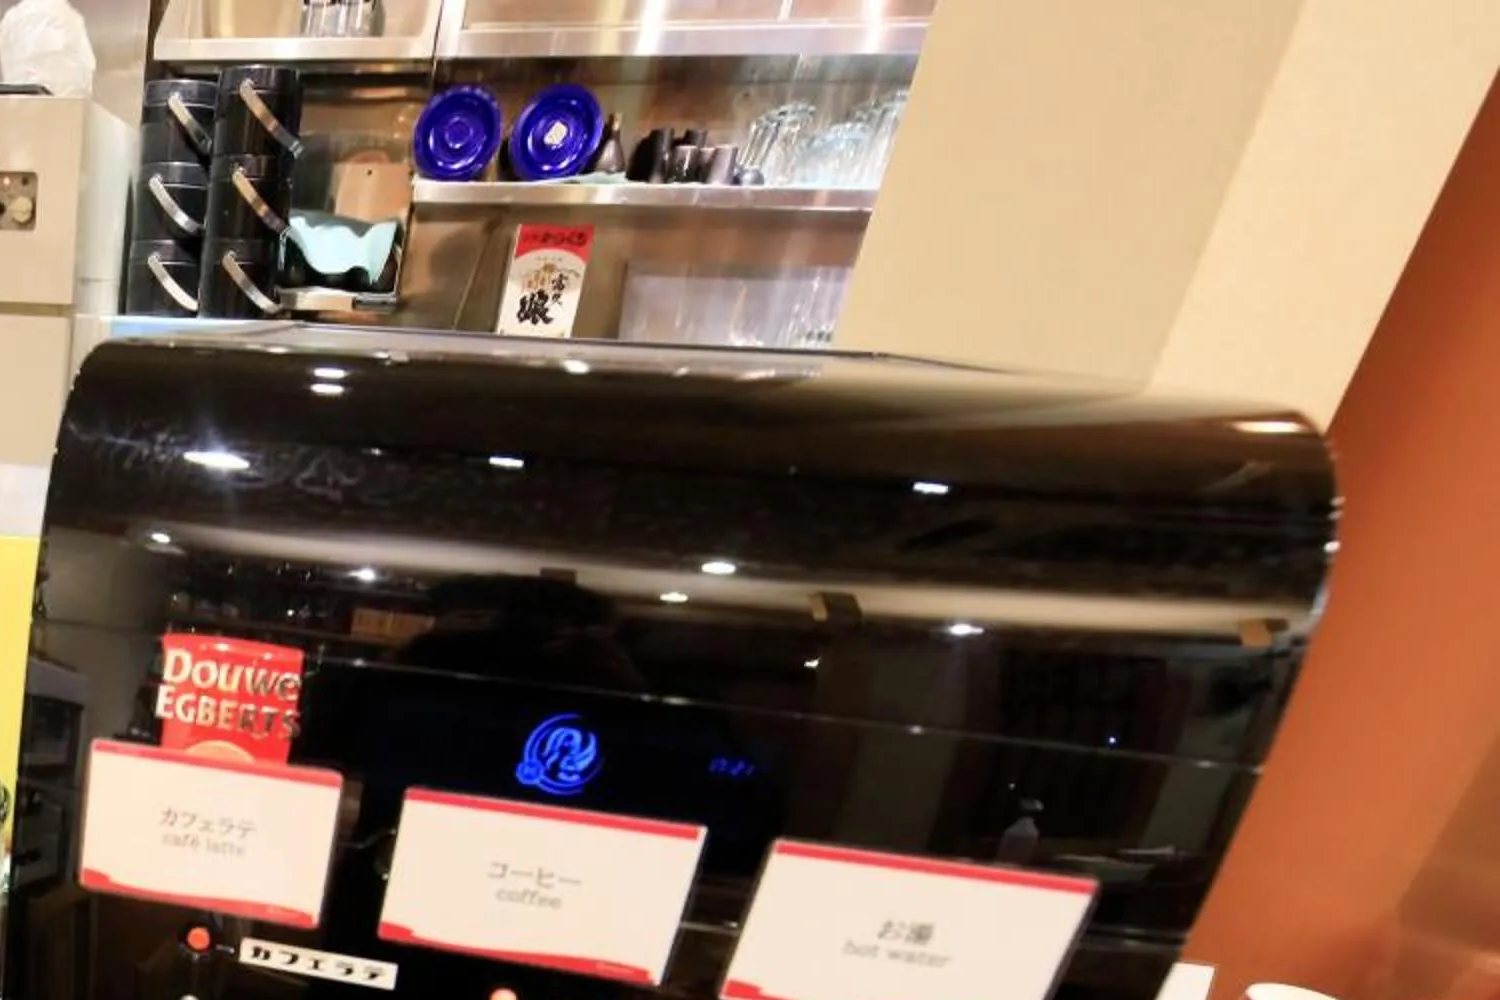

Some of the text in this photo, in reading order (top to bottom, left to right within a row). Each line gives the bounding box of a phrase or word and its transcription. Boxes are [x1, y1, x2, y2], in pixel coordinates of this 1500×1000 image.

[156, 684, 300, 741] EGBERTS
[159, 807, 257, 839] カフェラテ
[487, 860, 582, 890] コーヒー
[495, 887, 563, 911] coffee
[877, 919, 935, 947] お湯
[250, 945, 385, 981] カフェラテ
[841, 939, 952, 969] hot water
